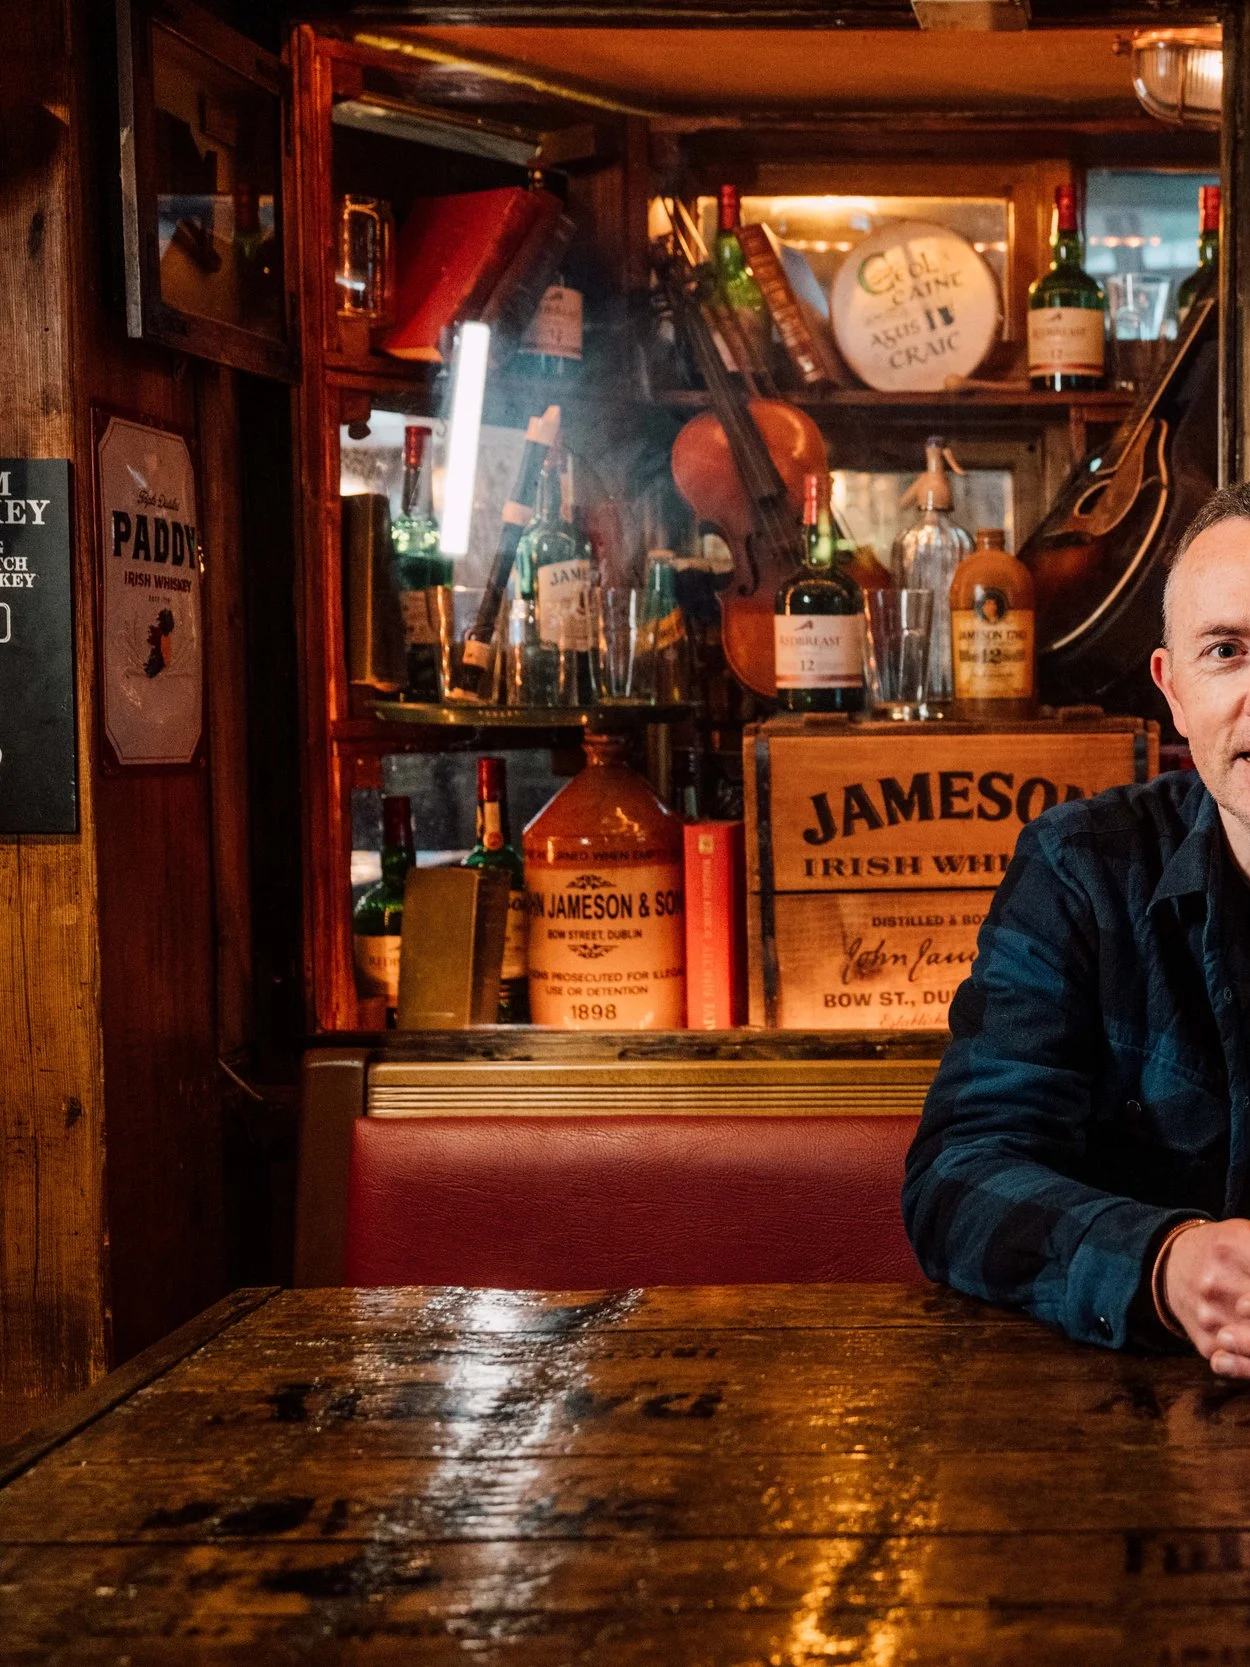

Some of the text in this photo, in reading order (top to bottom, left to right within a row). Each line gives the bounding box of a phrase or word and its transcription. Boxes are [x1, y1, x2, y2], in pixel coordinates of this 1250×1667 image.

[111, 510, 196, 570] PADDY
[124, 570, 192, 593] IRISH WHISKEY
[801, 659, 815, 671] 12
[804, 854, 921, 878] IRISH
[548, 892, 633, 919] JAMESON
[639, 892, 650, 918] &
[872, 914, 944, 928] DISTILLED
[548, 929, 566, 940] BOW
[608, 929, 643, 940] DUBLIN
[842, 937, 909, 985] John
[552, 971, 623, 983] PROSECUTED
[627, 971, 649, 981] FOR
[546, 985, 649, 996] USE OR DETENTION
[824, 993, 872, 1008] BOW
[571, 1003, 617, 1020] 1898
